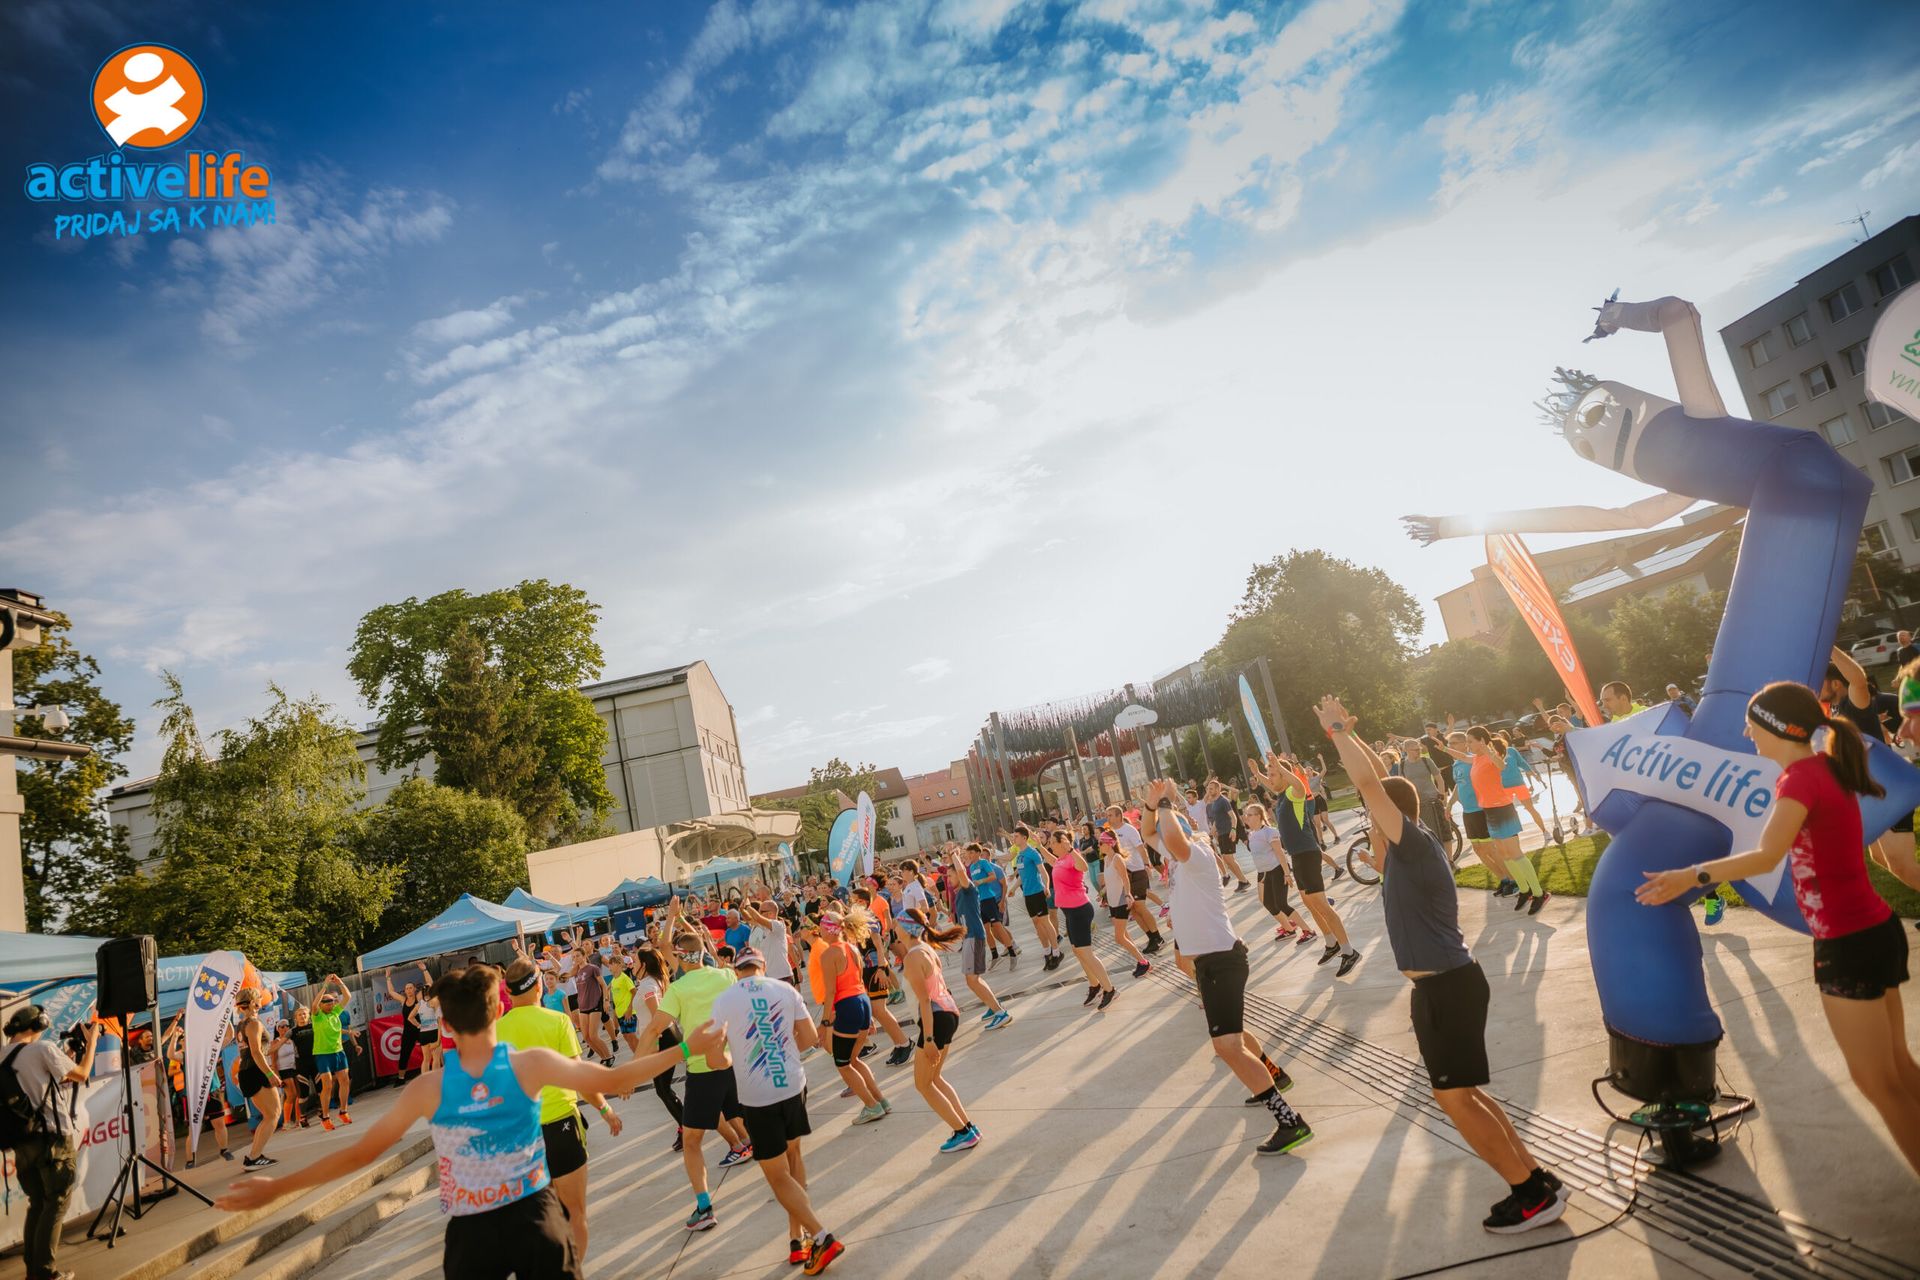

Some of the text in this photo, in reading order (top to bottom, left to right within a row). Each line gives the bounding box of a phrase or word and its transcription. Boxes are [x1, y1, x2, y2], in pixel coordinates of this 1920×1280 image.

[1600, 734, 1771, 817] Active life
[213, 1006, 231, 1044] Košice
[751, 998, 789, 1088] RUNNING
[455, 1178, 523, 1208] PRIDAJ
